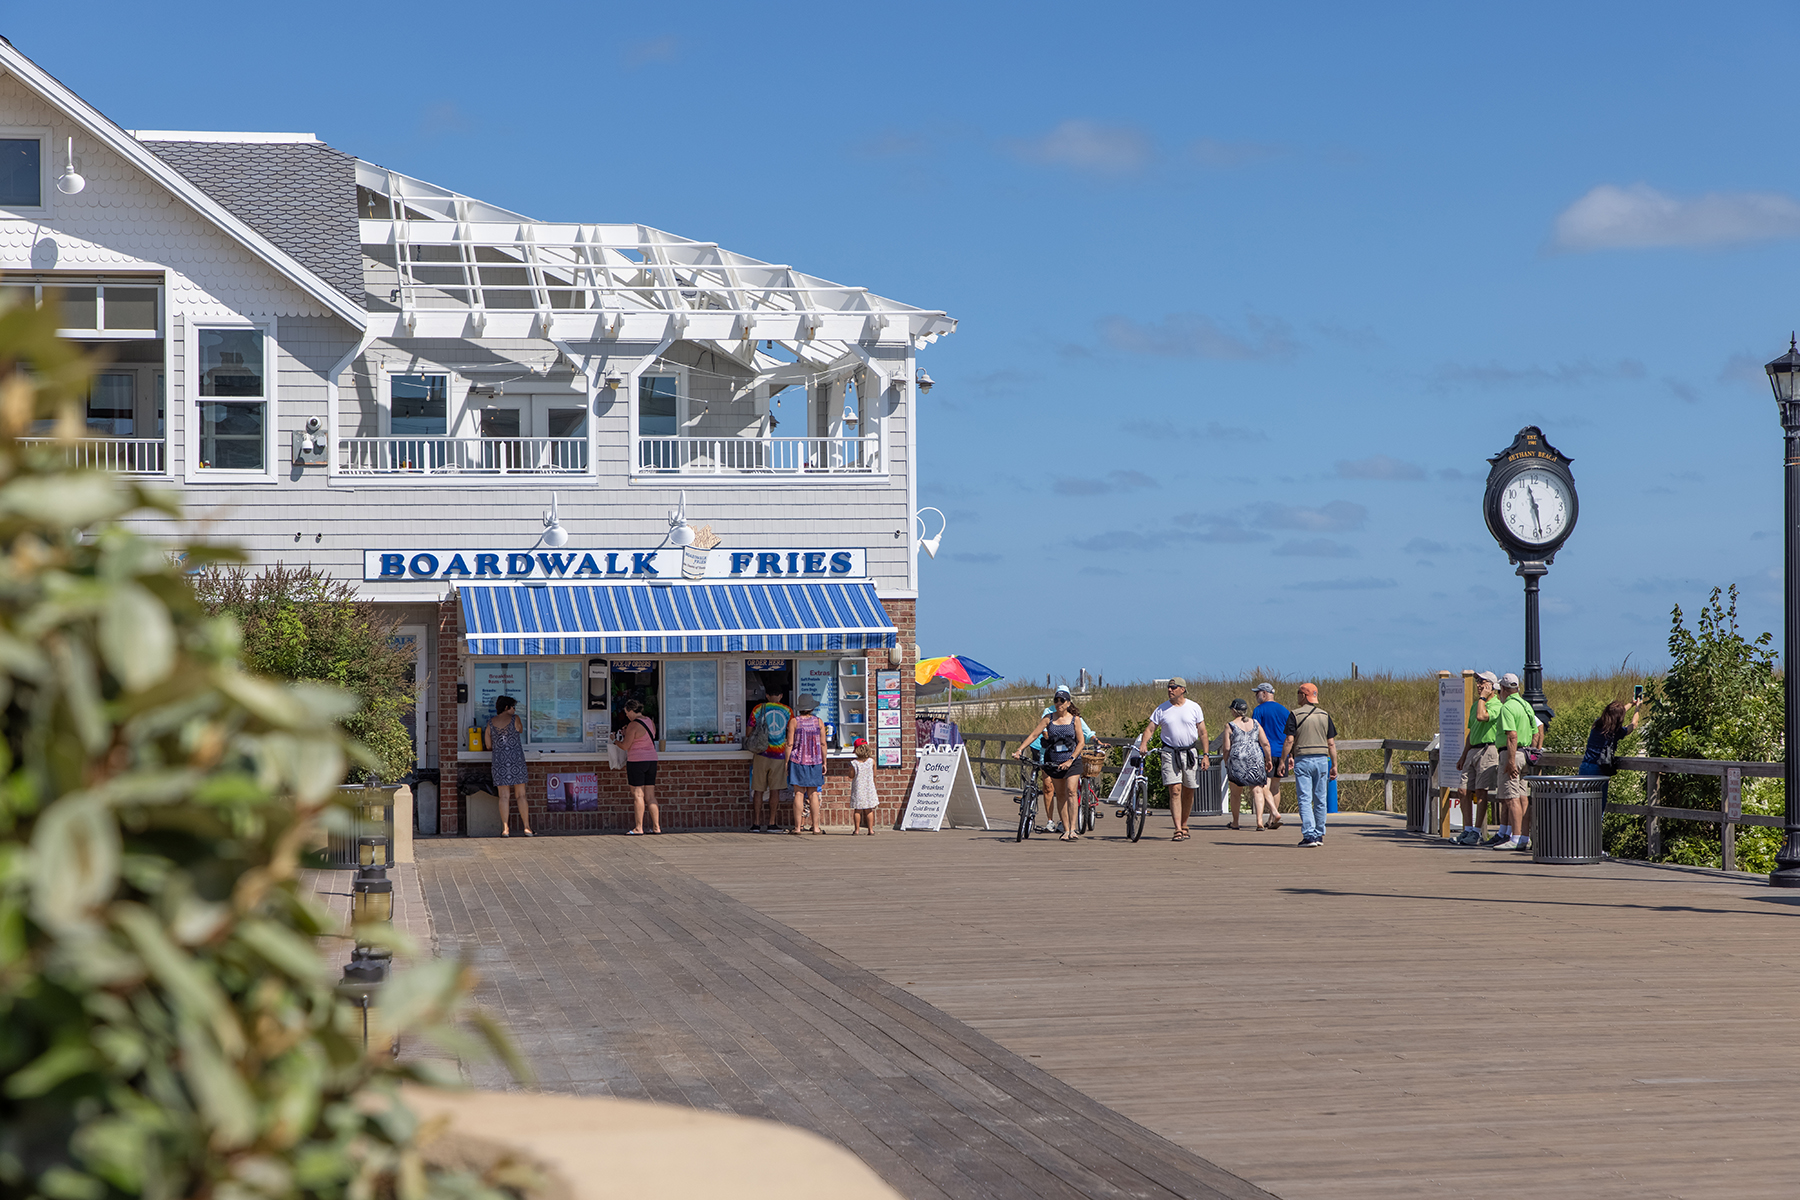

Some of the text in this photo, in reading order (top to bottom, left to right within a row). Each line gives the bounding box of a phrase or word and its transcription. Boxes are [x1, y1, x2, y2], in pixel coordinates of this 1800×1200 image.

[1508, 450, 1558, 463] BETHANY BEACH
[1519, 478, 1526, 489] 11
[1530, 474, 1539, 485] 12
[1545, 478, 1549, 489] 1
[1508, 489, 1517, 500] 10
[1554, 488, 1560, 499] 2
[1506, 501, 1512, 512] 9
[1558, 501, 1564, 512] 3
[1509, 513, 1516, 525] 8
[1554, 513, 1560, 525] 4
[1518, 524, 1525, 535] 7
[1532, 527, 1538, 538] 6
[1545, 523, 1552, 535] 5
[379, 551, 853, 577] BOARDWALK FRIES
[924, 763, 951, 772] Coffee
[575, 774, 598, 783] NITRO
[569, 785, 598, 794] COFFEE
